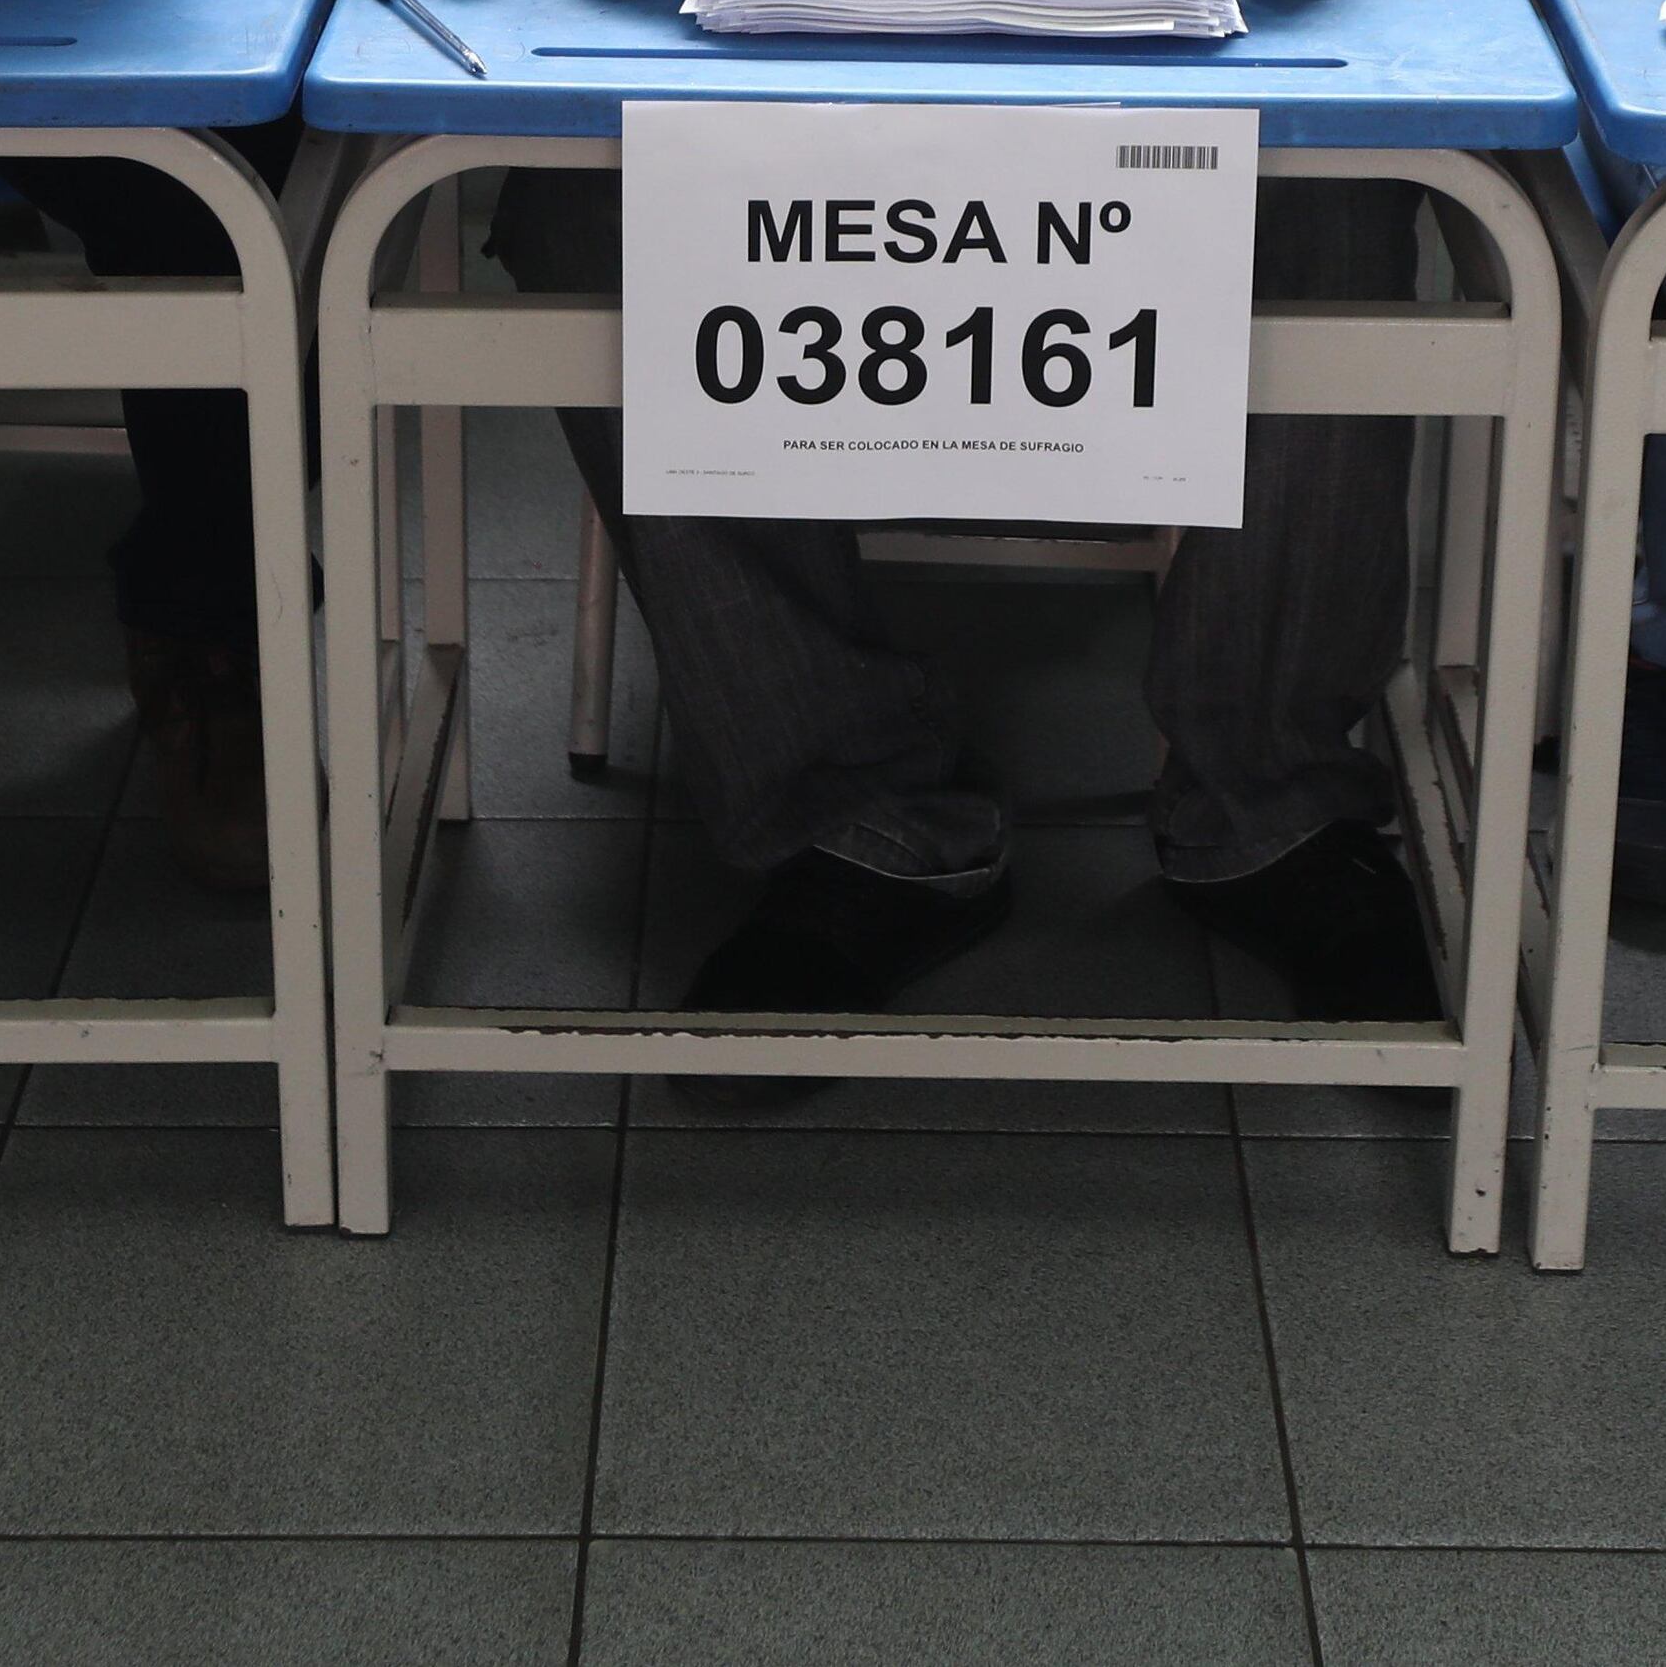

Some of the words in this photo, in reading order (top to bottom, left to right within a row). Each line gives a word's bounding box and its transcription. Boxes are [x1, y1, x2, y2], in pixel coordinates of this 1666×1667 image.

[747, 199, 1007, 264] MESA
[1036, 200, 1132, 265] Nº
[695, 305, 1158, 408] 038161
[783, 439, 817, 450] PARA
[819, 440, 845, 451] SER
[847, 439, 919, 451] COLOCADO
[922, 439, 939, 450] EN
[942, 440, 959, 450] LA
[961, 440, 997, 451] MESA
[999, 440, 1016, 451] DE
[1019, 441, 1084, 454] SUFRAGIO
